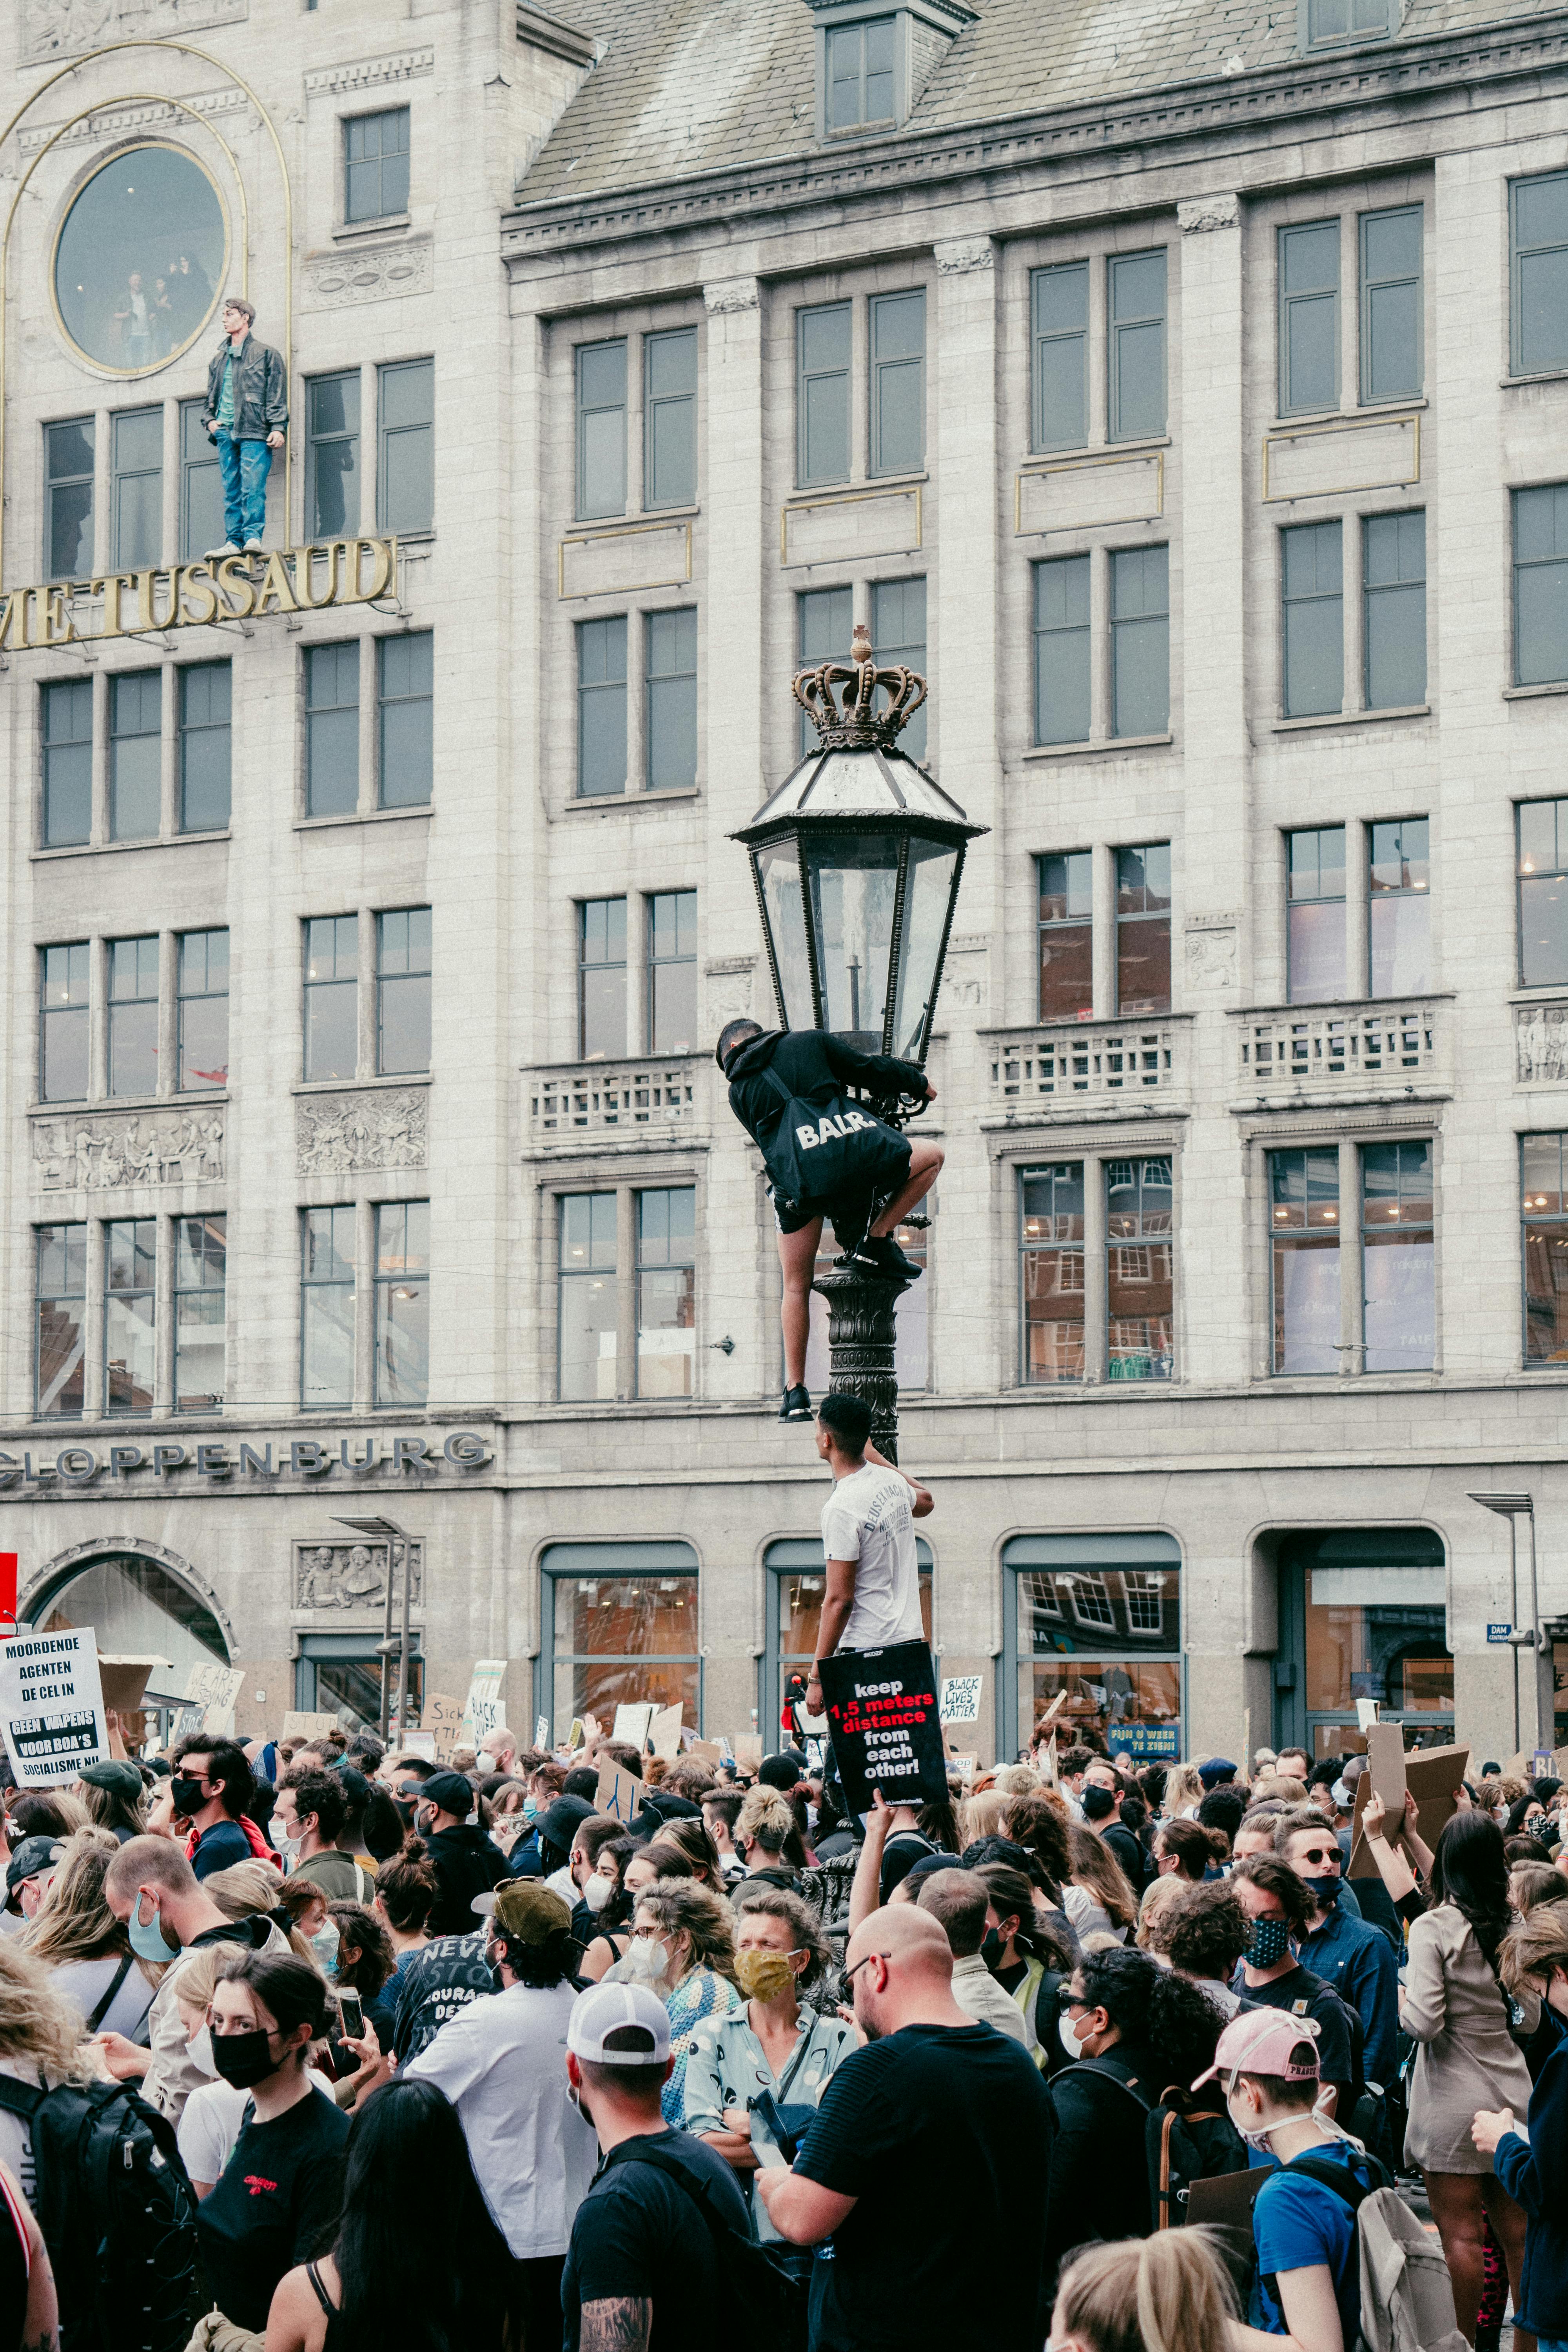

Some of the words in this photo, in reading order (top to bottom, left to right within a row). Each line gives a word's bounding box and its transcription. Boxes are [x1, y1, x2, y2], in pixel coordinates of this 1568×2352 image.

[91, 538, 392, 635] TUSSAUD
[796, 1111, 877, 1150] BALR.
[1491, 1626, 1507, 1634] DAM
[5, 1637, 80, 1659] MOORDENDE
[20, 1661, 71, 1679] AGENTEN
[22, 1688, 37, 1702] DE
[40, 1684, 60, 1699] CEL
[62, 1682, 74, 1696] IN
[854, 1681, 903, 1698] keep
[947, 1678, 979, 1692] BLACK
[830, 1700, 860, 1720] 1,5
[865, 1693, 934, 1713] meters
[946, 1690, 973, 1705] LIVES
[940, 1702, 975, 1719] MATTER
[11, 1718, 41, 1736] GEEN
[44, 1710, 94, 1731] WAPENS
[842, 1711, 927, 1733] distance
[864, 1730, 910, 1746] from
[1111, 1730, 1133, 1740] FIJN
[1136, 1730, 1144, 1739] U
[1147, 1730, 1175, 1739] WEER
[20, 1740, 53, 1757] VOOR
[53, 1733, 92, 1754] BOA'S
[866, 1743, 913, 1762] each
[1132, 1741, 1144, 1750] TE
[1147, 1741, 1175, 1750] ZIEN!
[864, 1759, 919, 1779] other!
[1290, 2066, 1316, 2075] PRAGUE
